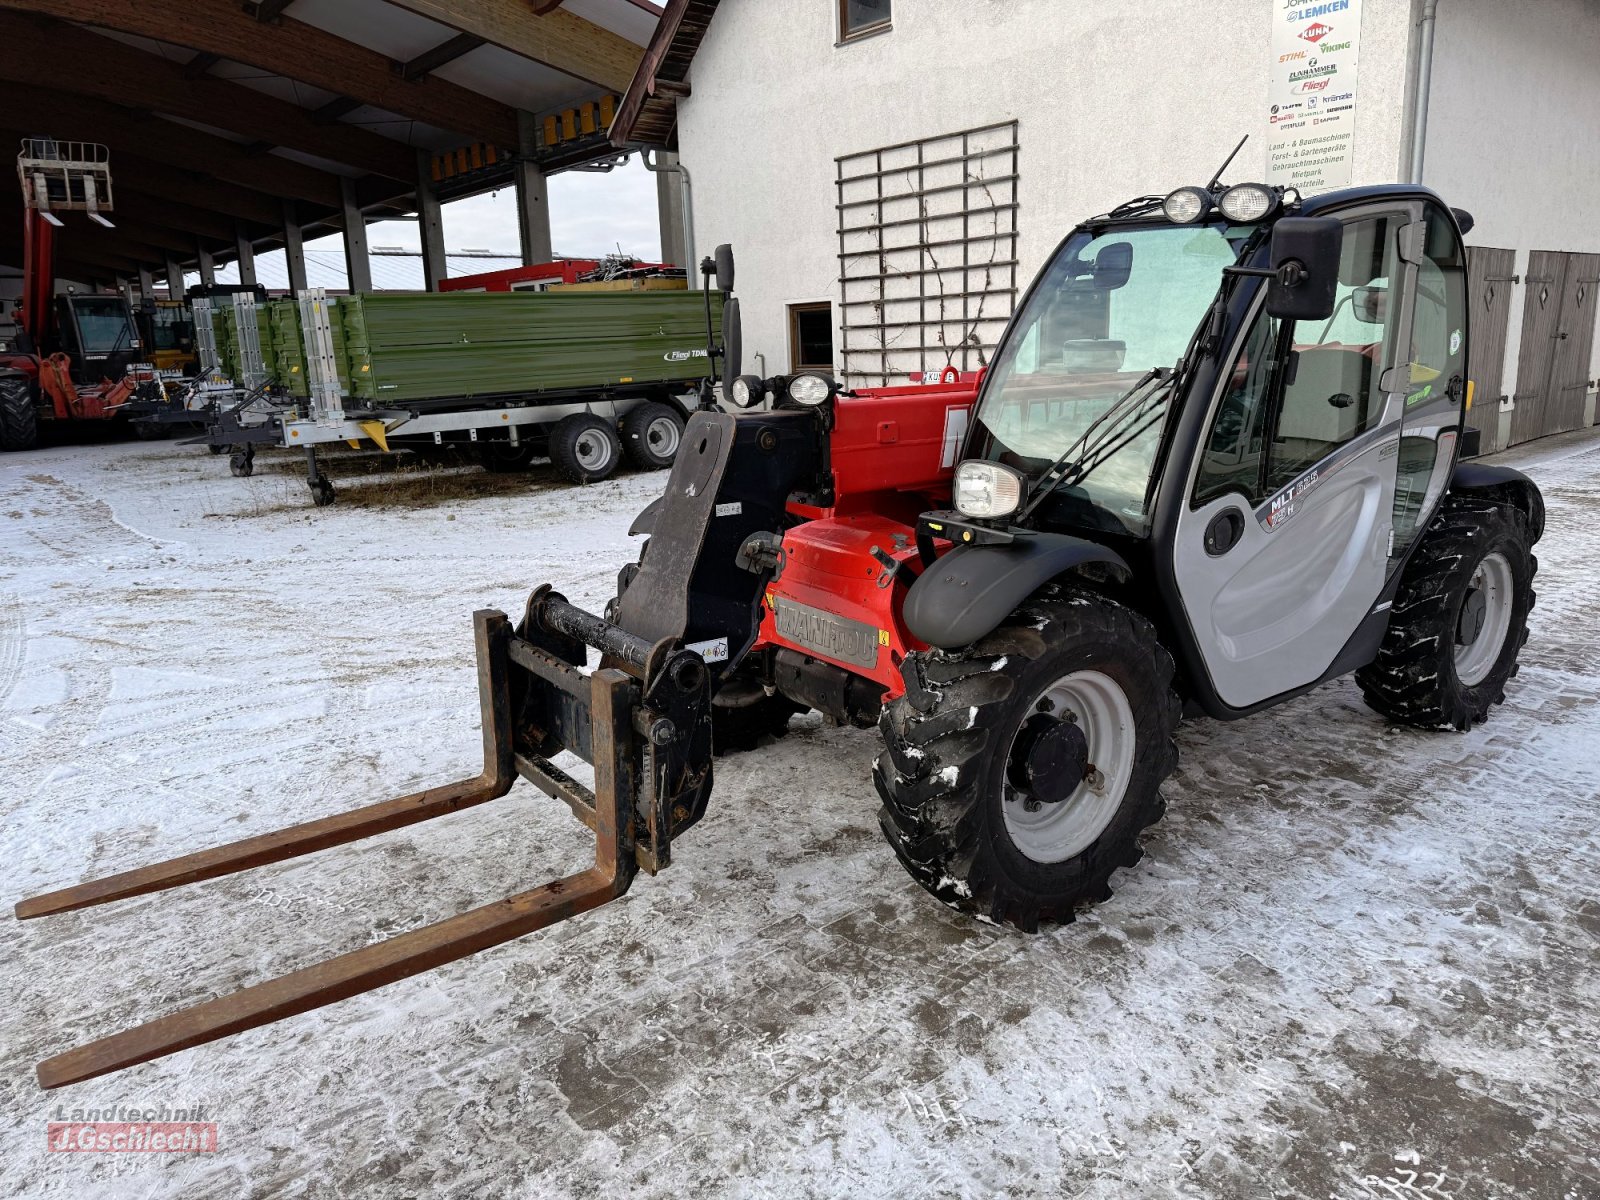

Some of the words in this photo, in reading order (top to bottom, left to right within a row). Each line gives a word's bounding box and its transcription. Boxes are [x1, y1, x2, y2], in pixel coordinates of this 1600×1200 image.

[1298, 0, 1349, 20] LEMKEN
[1302, 26, 1329, 39] KUHN
[1320, 41, 1351, 54] VIKING
[1279, 51, 1307, 63] STIHL
[1302, 78, 1330, 91] Fliegl
[1269, 142, 1285, 151] Land
[1299, 132, 1351, 147] Baumaschinen
[1272, 152, 1291, 161] Forst-
[1300, 143, 1346, 158] Gartengeräte
[1272, 155, 1344, 172] Gebrauchtmaschinen
[1291, 168, 1322, 179] Mietpark
[1289, 179, 1325, 189] Ersatzteile
[1271, 486, 1295, 513] MLT
[1287, 504, 1294, 516] H
[777, 604, 876, 662] MANITOU
